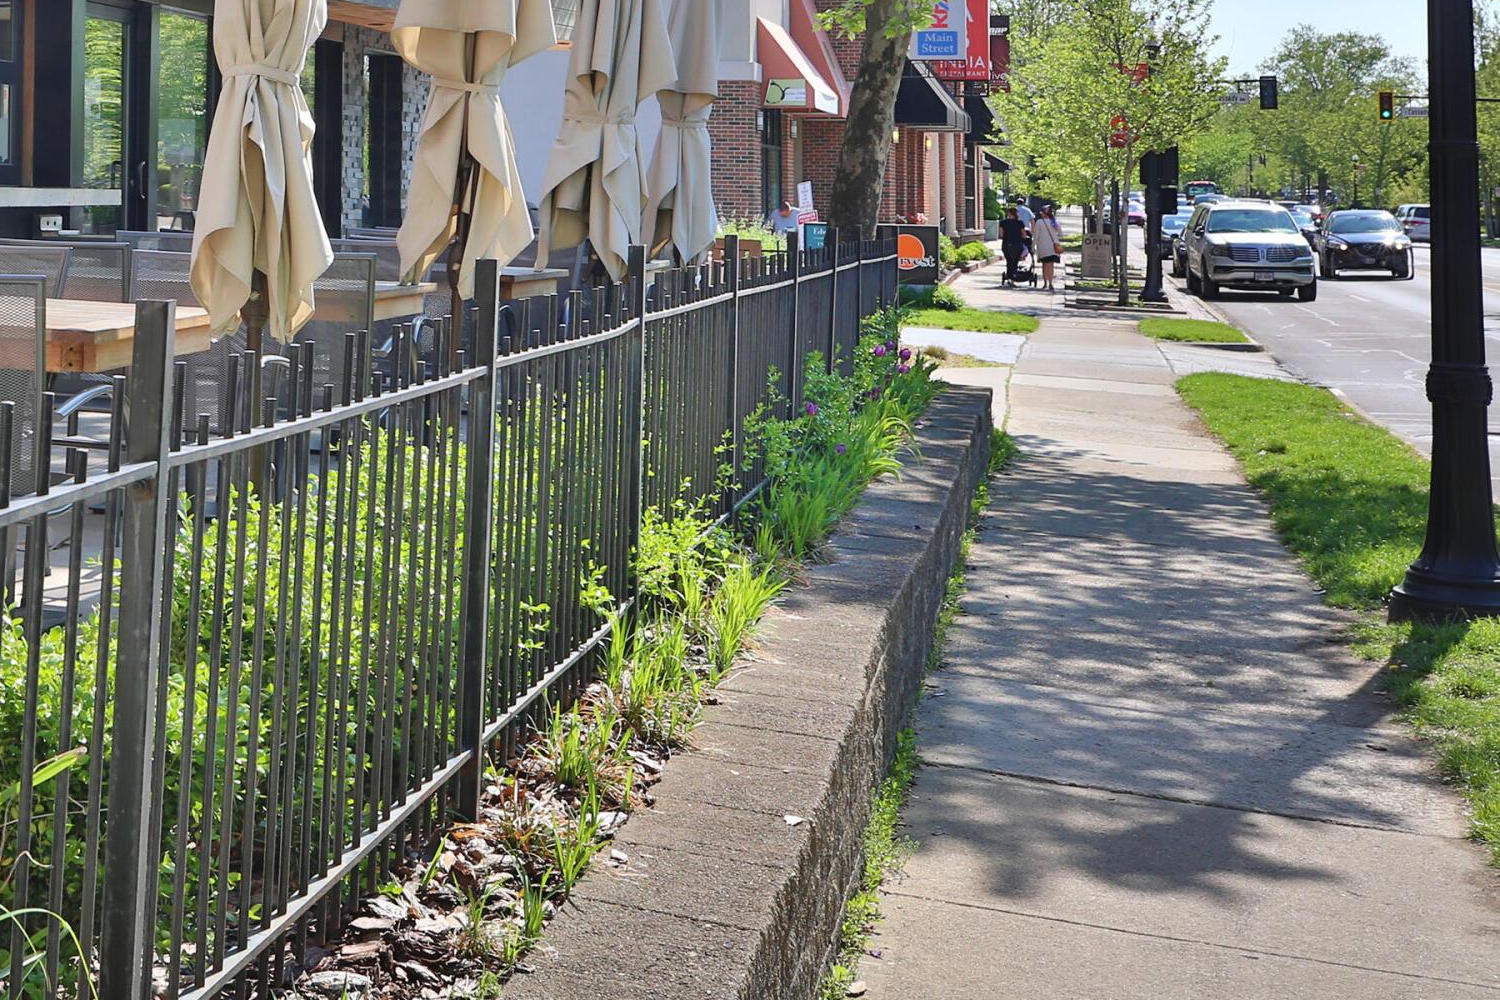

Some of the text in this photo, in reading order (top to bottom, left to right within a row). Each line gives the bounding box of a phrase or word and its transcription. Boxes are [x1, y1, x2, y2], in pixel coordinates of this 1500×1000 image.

[924, 32, 953, 42] Main
[921, 42, 954, 53] Street
[1085, 238, 1110, 246] OPEN
[898, 255, 936, 267] rvest
